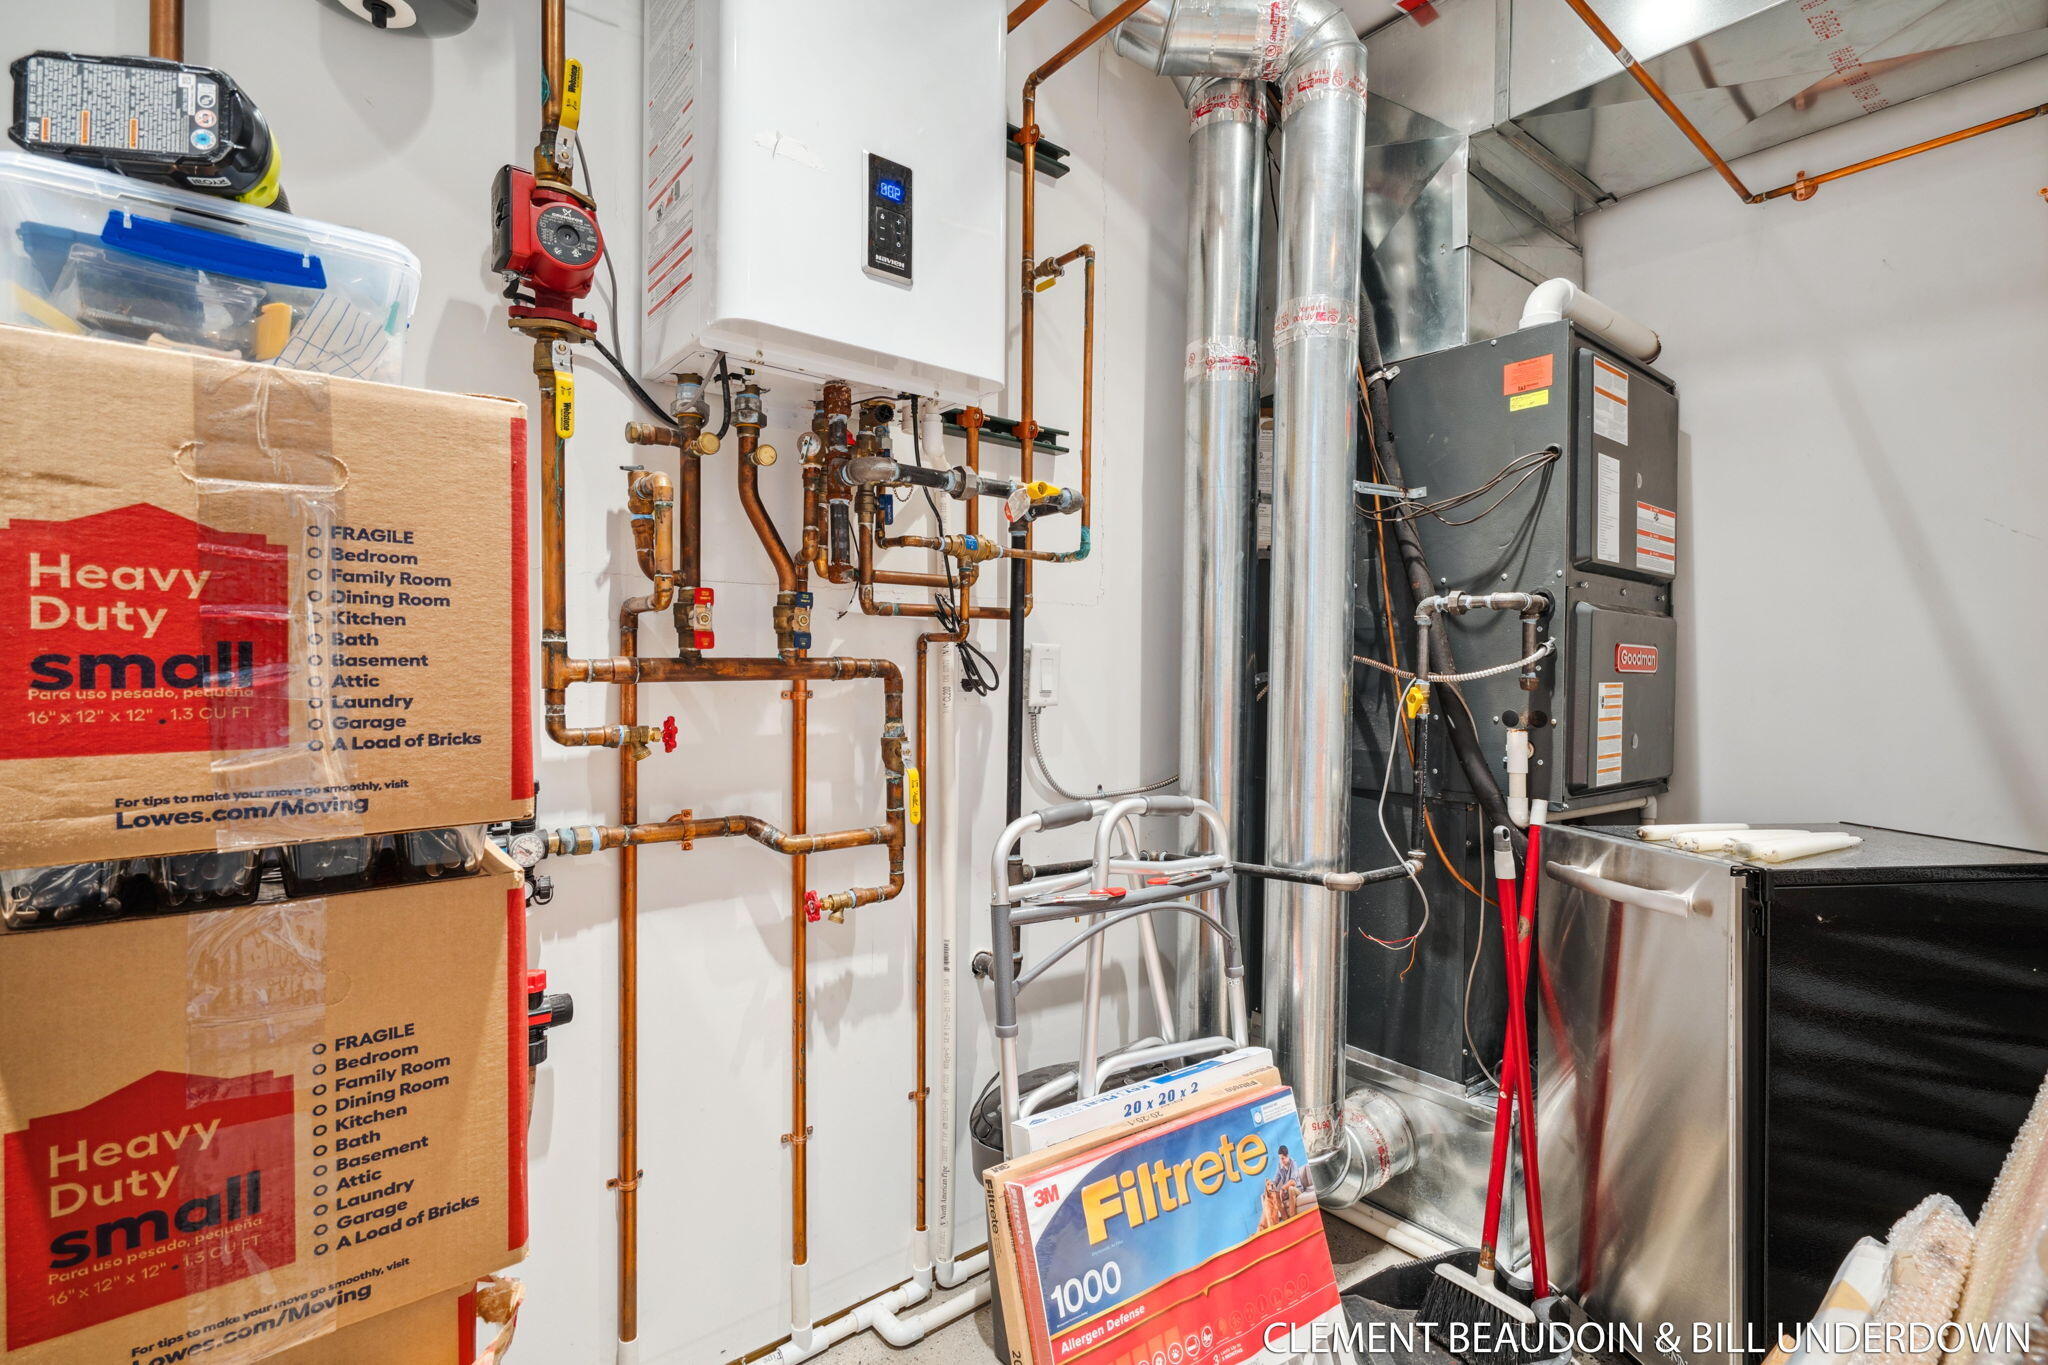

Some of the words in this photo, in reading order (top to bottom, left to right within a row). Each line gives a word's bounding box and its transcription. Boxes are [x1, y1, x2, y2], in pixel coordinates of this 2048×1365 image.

[331, 526, 414, 544] FRAGILE
[331, 547, 418, 565] Bedroom
[29, 552, 212, 599] Heavy
[331, 568, 395, 587] Family
[400, 572, 452, 587] Room
[331, 590, 394, 608] Dining
[398, 592, 451, 607] Room
[30, 595, 168, 639] Duty
[331, 611, 406, 626] Kitchen
[331, 632, 379, 646] Bath
[30, 641, 253, 690] small
[331, 652, 429, 667] Basement
[1621, 650, 1656, 667] Goodman
[28, 689, 71, 702] Para
[76, 690, 107, 701] uso
[111, 688, 179, 702] pesado,
[331, 673, 380, 688] Attic
[28, 710, 56, 725] 16"
[60, 713, 70, 725] x
[76, 710, 103, 723] 12"
[110, 711, 121, 723] x
[126, 708, 153, 722] 12"
[171, 707, 194, 721] 1.3
[199, 706, 227, 721] CU
[231, 706, 251, 720] FT
[331, 694, 414, 710] Laundry
[332, 716, 407, 731] Garage
[331, 736, 348, 751] A
[351, 734, 400, 750] Load
[404, 733, 425, 748] of
[428, 732, 482, 747] Bricks
[115, 797, 140, 808] For
[143, 793, 170, 808] tips
[173, 794, 189, 804] to
[191, 791, 230, 803] make
[233, 788, 264, 802] your
[266, 786, 301, 798] move
[304, 785, 320, 798] go
[323, 781, 382, 795] smoothly,
[384, 779, 409, 790] visit
[115, 796, 369, 830] Lowes.com/Moving
[335, 1023, 415, 1052] FRAGILE
[335, 1045, 419, 1072] Bedroom
[335, 1068, 397, 1092] Family
[401, 1056, 451, 1076] Room
[335, 1088, 395, 1112] Dining
[400, 1075, 449, 1096] Room
[1123, 1101, 1143, 1119] 20
[1145, 1100, 1155, 1112] x
[1158, 1089, 1176, 1107] 20
[1180, 1089, 1188, 1099] x
[1190, 1082, 1199, 1095] 2
[335, 1105, 407, 1132] Kitchen
[50, 1118, 221, 1178] Heavy
[336, 1130, 381, 1152] Bath
[336, 1136, 429, 1172] Basement
[50, 1165, 179, 1218] Duty
[336, 1169, 382, 1192] Attic
[336, 1178, 415, 1211] Laundry
[1081, 1132, 1268, 1246] Filtrete
[984, 1178, 999, 1235] Filtrete
[1033, 1184, 1060, 1208] 3M
[50, 1170, 261, 1269] small
[336, 1200, 408, 1229] Garage
[336, 1236, 352, 1251] A
[355, 1217, 402, 1244] Load
[405, 1210, 425, 1227] of
[428, 1196, 480, 1221] Bricks
[1008, 1187, 1026, 1245] Filtrete
[48, 1267, 89, 1285] Para
[93, 1256, 123, 1273] uso
[126, 1239, 190, 1266] pesado,
[49, 1288, 76, 1307] 16"
[79, 1288, 89, 1299] x
[94, 1274, 120, 1293] 12"
[126, 1273, 136, 1286] x
[141, 1261, 167, 1280] 12"
[183, 1251, 205, 1267] 1.3
[209, 1242, 236, 1260] CU
[241, 1233, 263, 1252] FT
[1050, 1261, 1122, 1319] 1000
[130, 1344, 156, 1358] For
[157, 1332, 184, 1350] tips
[186, 1327, 201, 1339] to
[202, 1315, 241, 1334] make
[243, 1303, 273, 1323] your
[274, 1292, 308, 1310] move
[310, 1284, 326, 1301] go
[328, 1267, 385, 1293] smoothly,
[386, 1257, 410, 1273] visit
[1060, 1325, 1105, 1355] Allergen
[1106, 1303, 1146, 1333] Defense
